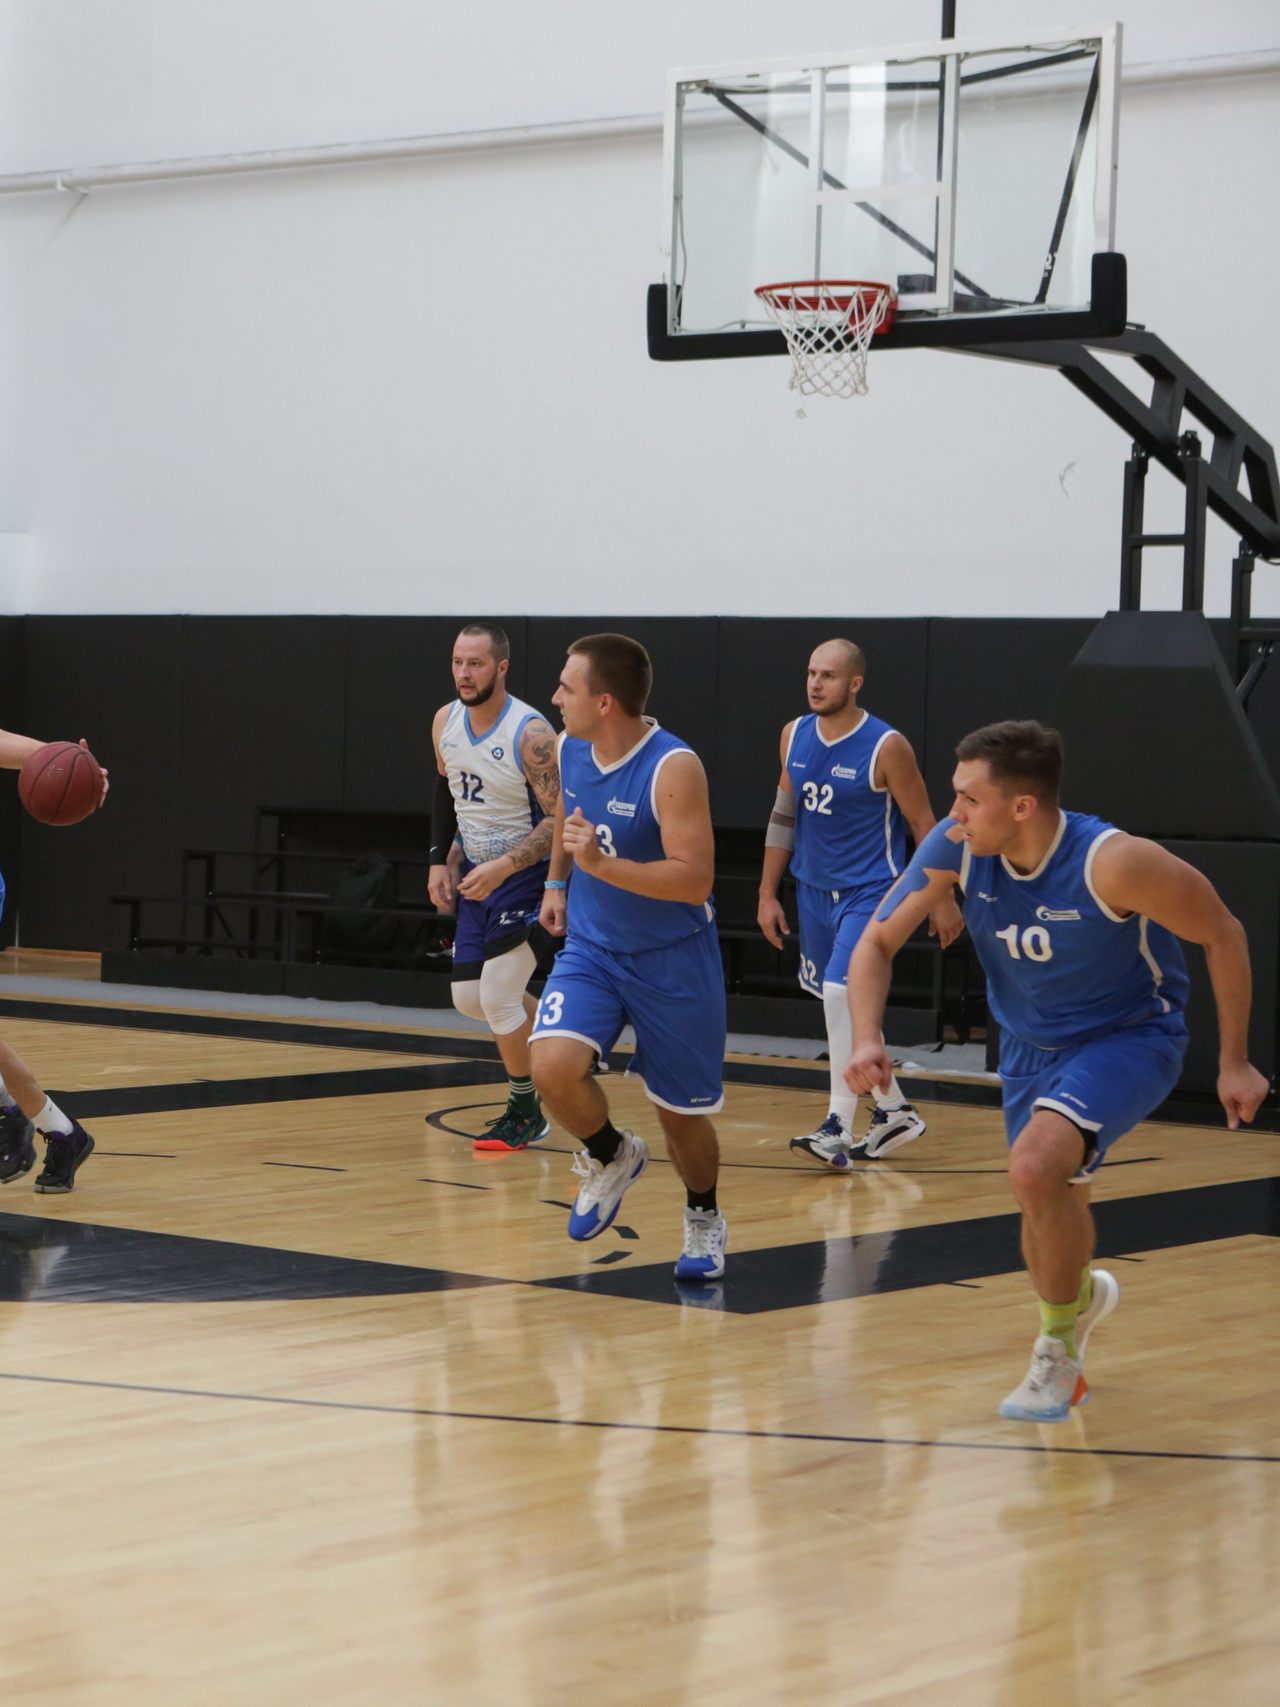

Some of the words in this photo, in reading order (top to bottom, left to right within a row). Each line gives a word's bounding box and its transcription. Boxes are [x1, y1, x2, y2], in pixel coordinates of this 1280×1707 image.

[460, 770, 485, 804] 12
[802, 781, 834, 815] 32
[595, 823, 618, 858] 3
[995, 924, 1053, 962] 10
[532, 990, 565, 1026] 3
